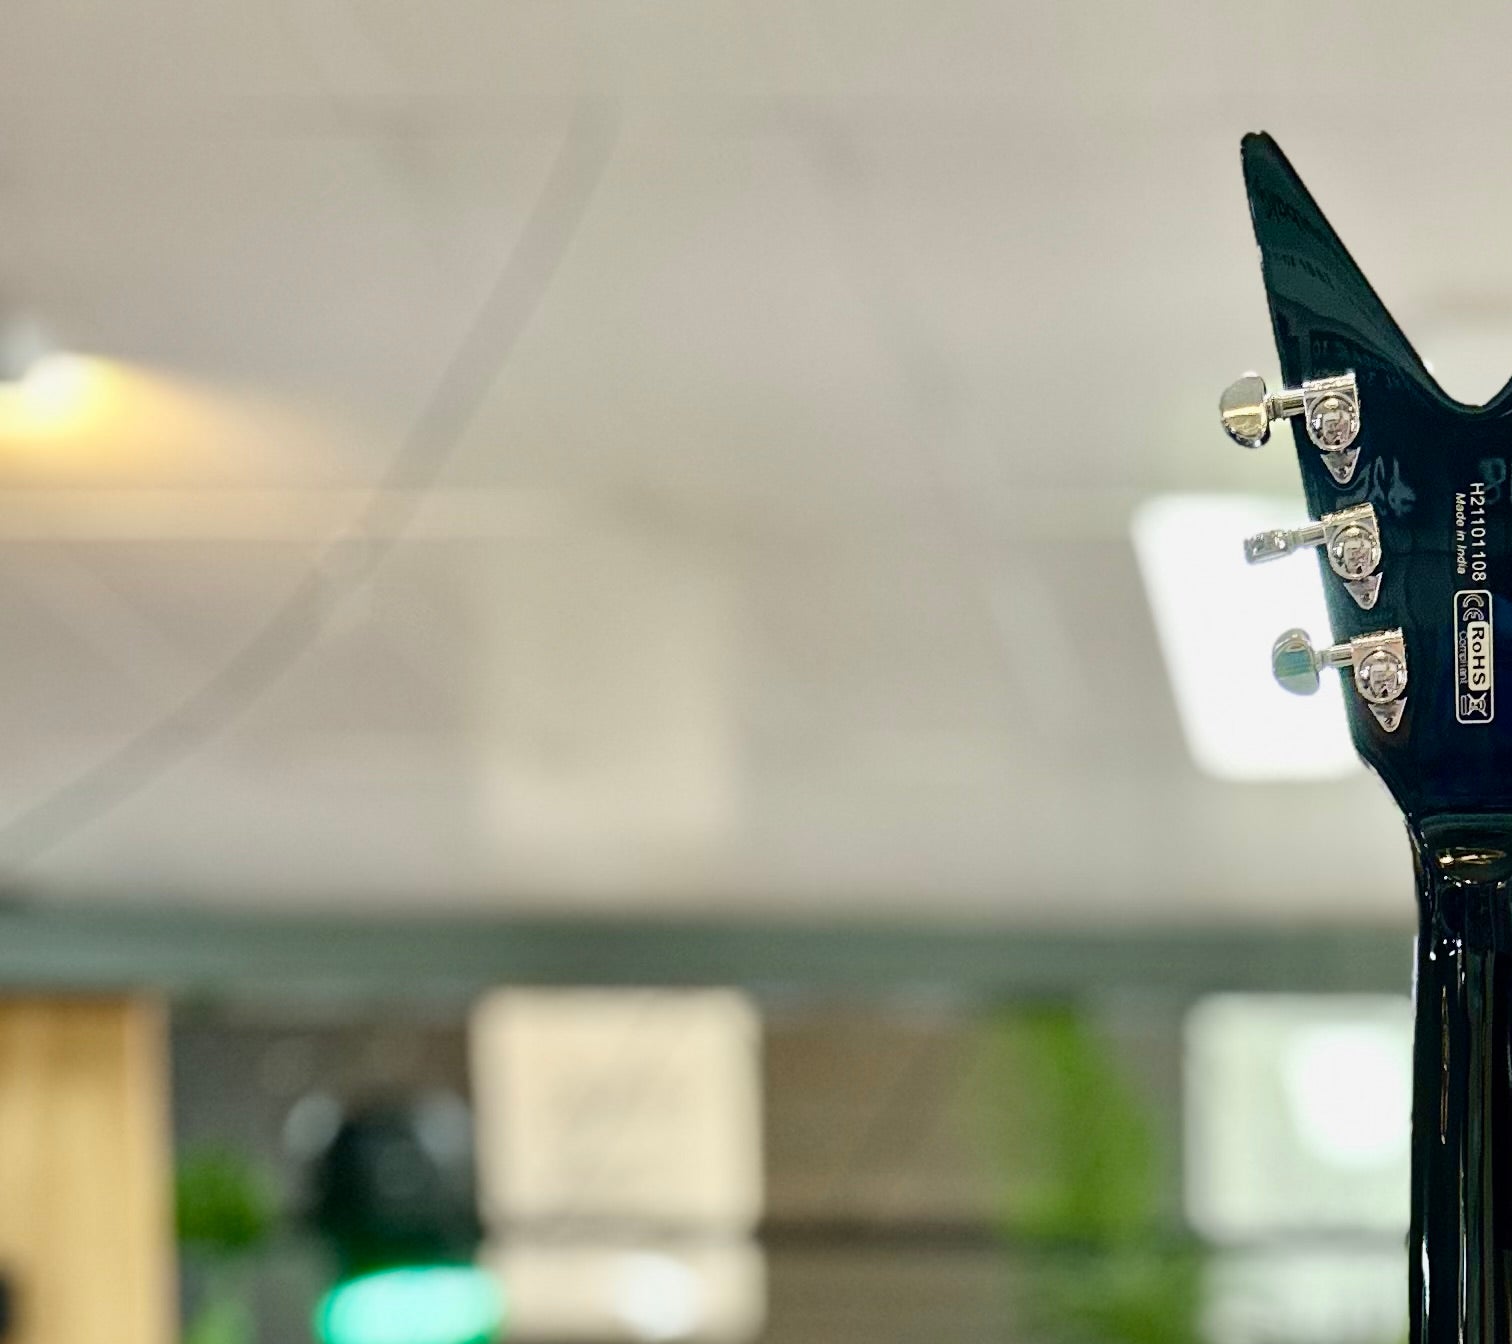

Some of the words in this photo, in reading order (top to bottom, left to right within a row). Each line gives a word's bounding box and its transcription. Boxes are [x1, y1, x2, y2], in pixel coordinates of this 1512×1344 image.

[1455, 492, 1466, 527] Made
[1456, 530, 1467, 541] in
[1469, 482, 1487, 581] H21101108
[1457, 544, 1468, 575] India
[1471, 627, 1486, 686] RoHS
